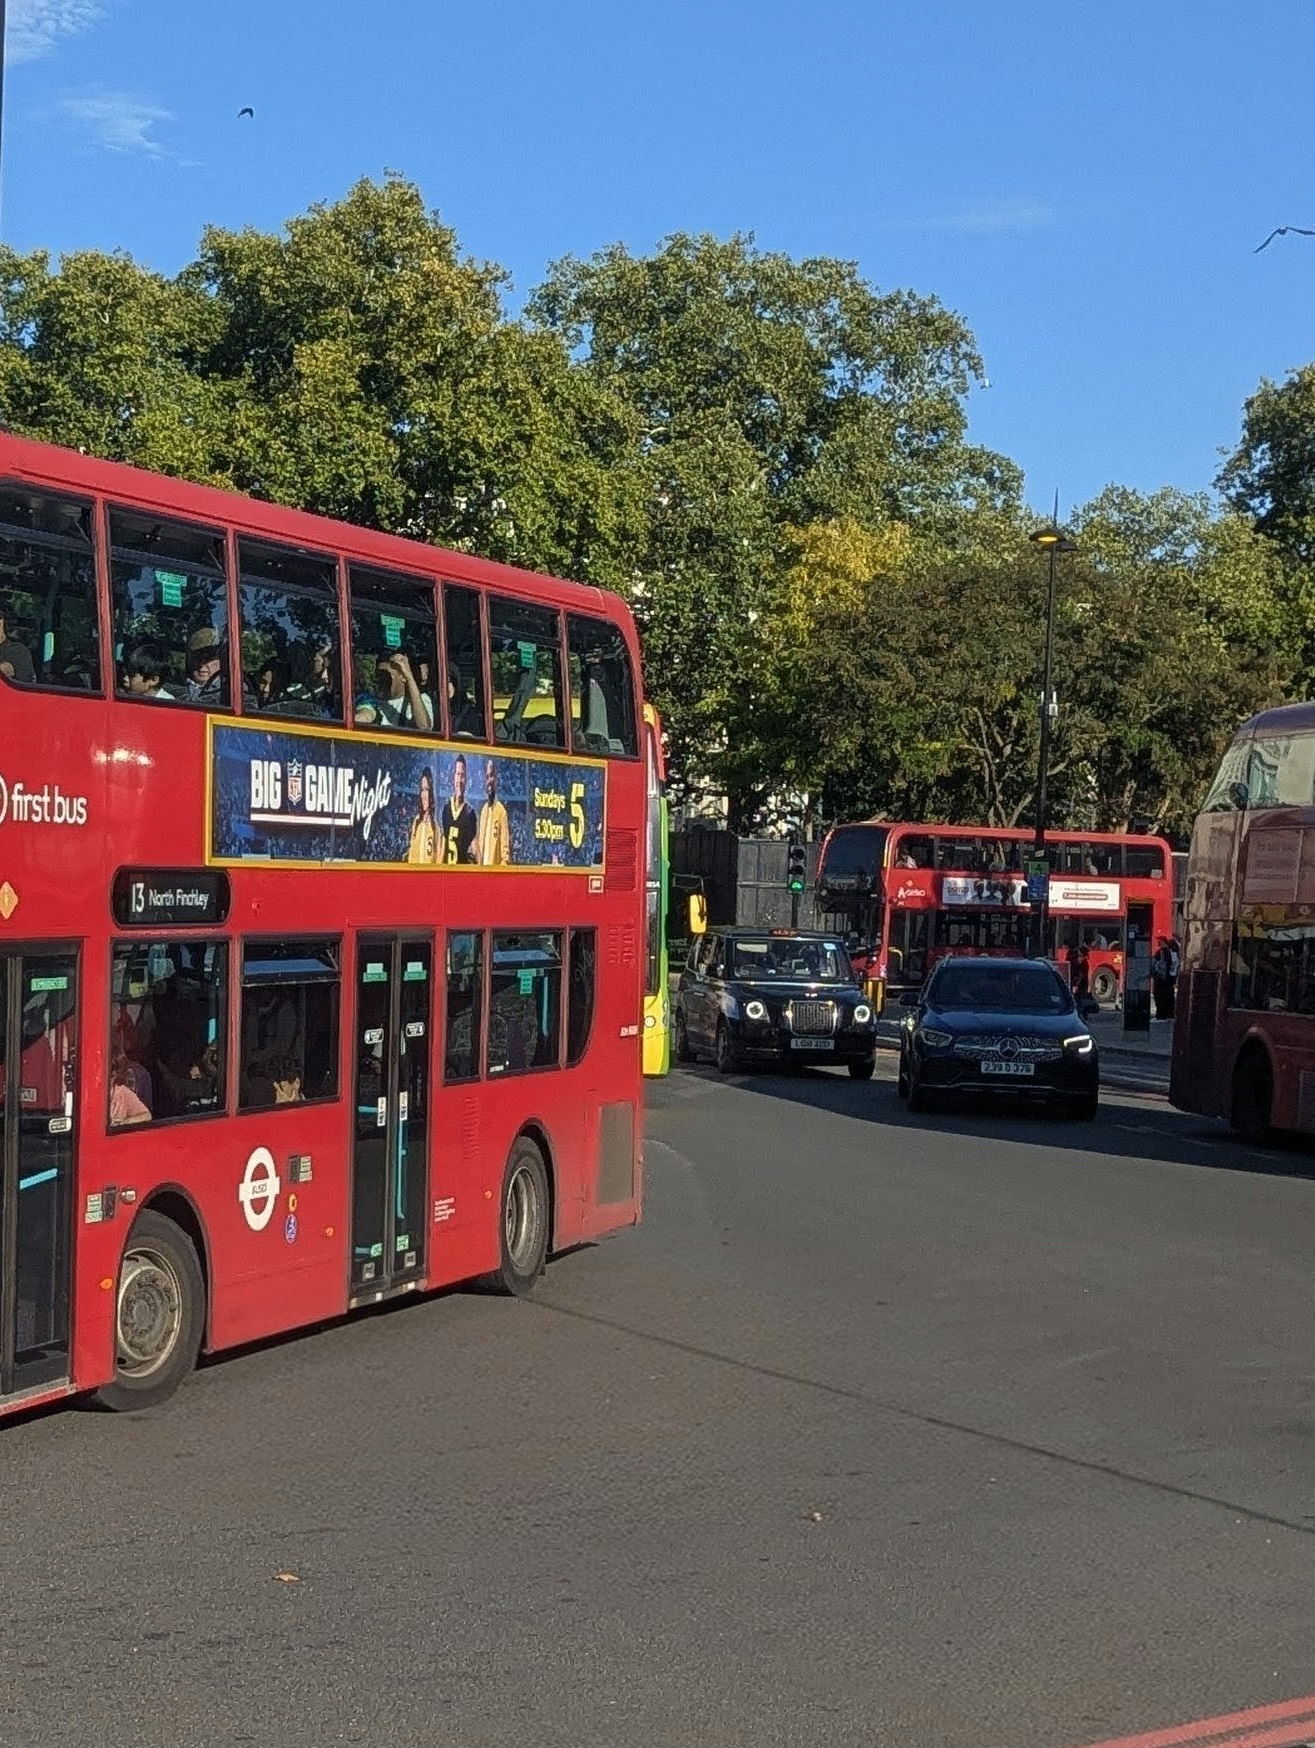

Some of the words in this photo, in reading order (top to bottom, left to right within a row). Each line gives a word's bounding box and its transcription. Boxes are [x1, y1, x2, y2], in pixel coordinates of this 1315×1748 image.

[11, 782, 51, 823] first
[53, 784, 87, 825] bus
[250, 759, 281, 810] BIG
[305, 764, 354, 814] GAME
[350, 768, 392, 841] Night
[534, 786, 566, 813] Sundays
[569, 783, 585, 849] 5
[131, 882, 145, 913] 13
[148, 888, 175, 906] North
[176, 888, 210, 910] Finchley
